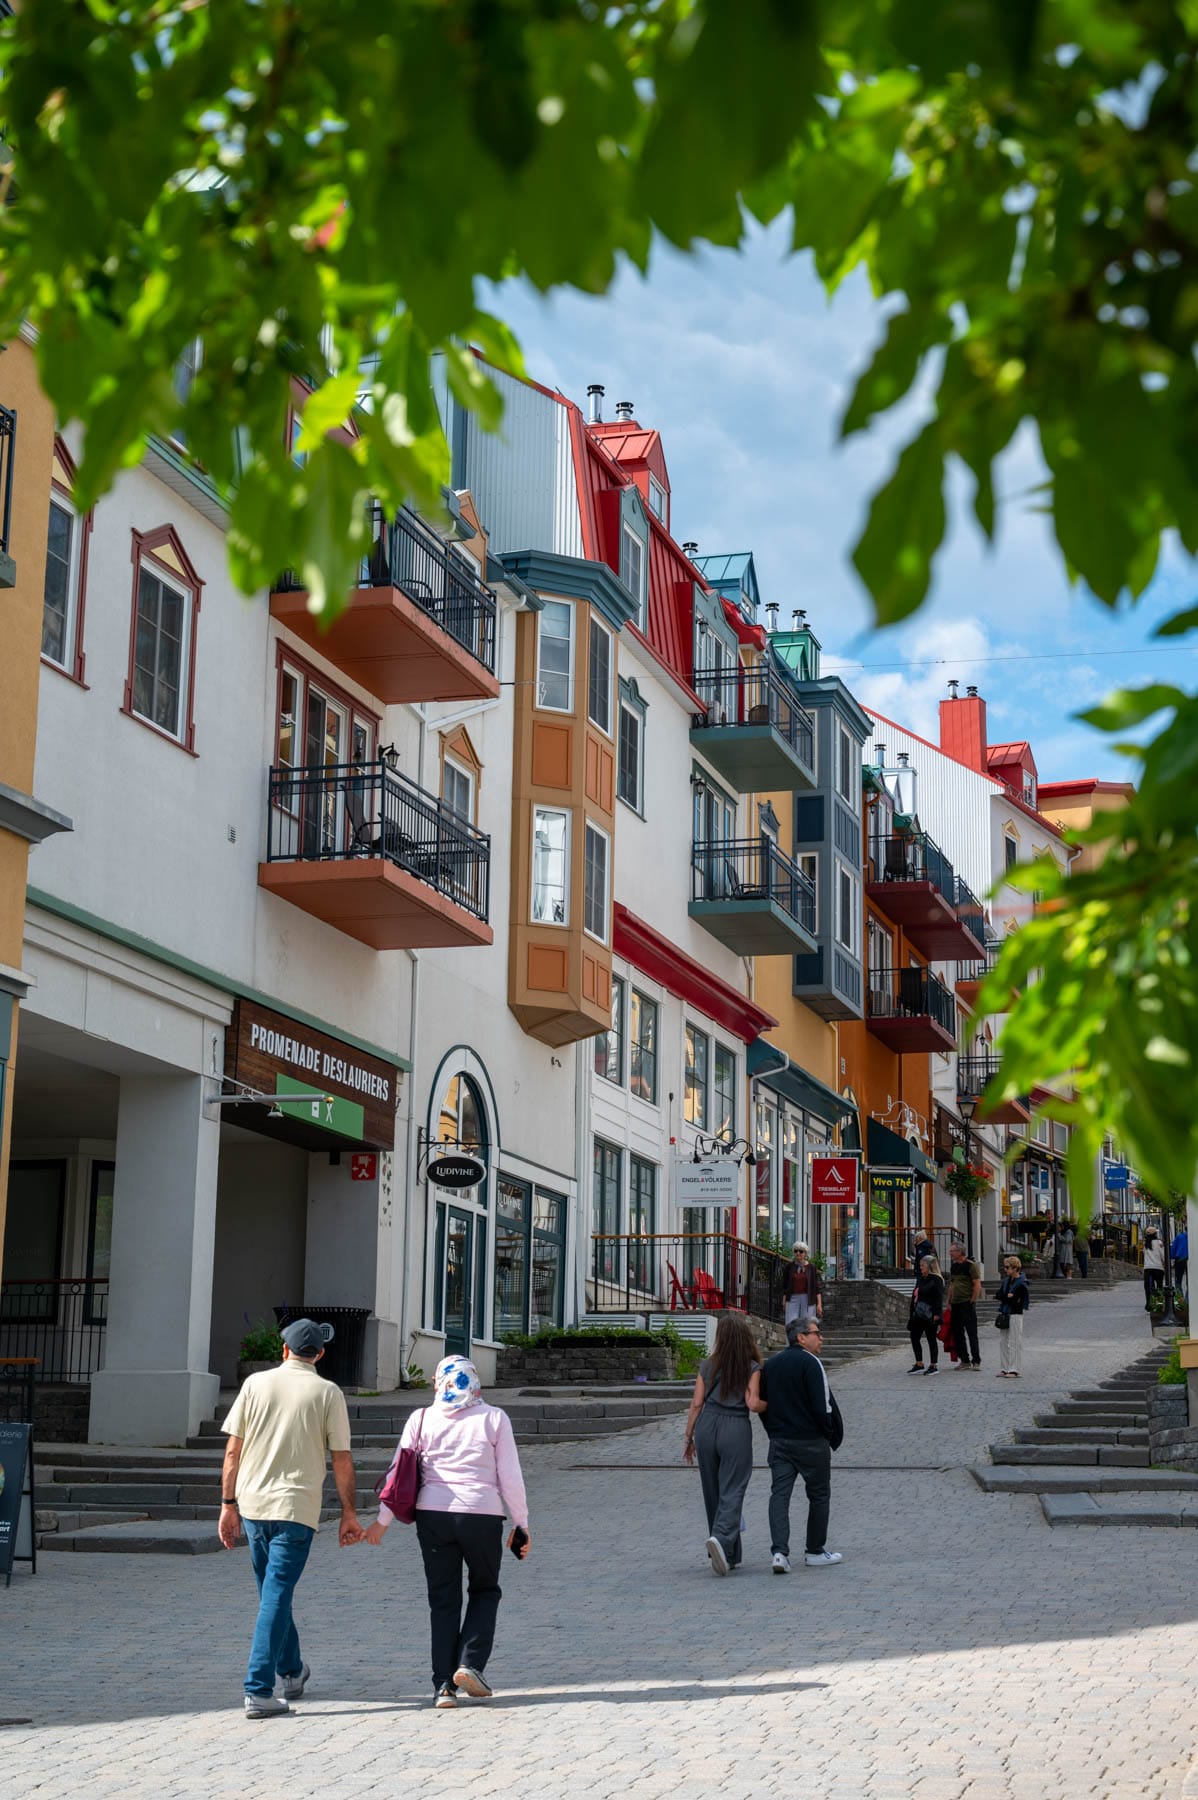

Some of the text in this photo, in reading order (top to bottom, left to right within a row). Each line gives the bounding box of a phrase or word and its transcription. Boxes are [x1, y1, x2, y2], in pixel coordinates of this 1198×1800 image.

[250, 1023, 389, 1101] PROMENADE DESLAURIERS
[436, 1166, 474, 1177] LUDIVINE
[872, 1176, 912, 1189] Viva Thé
